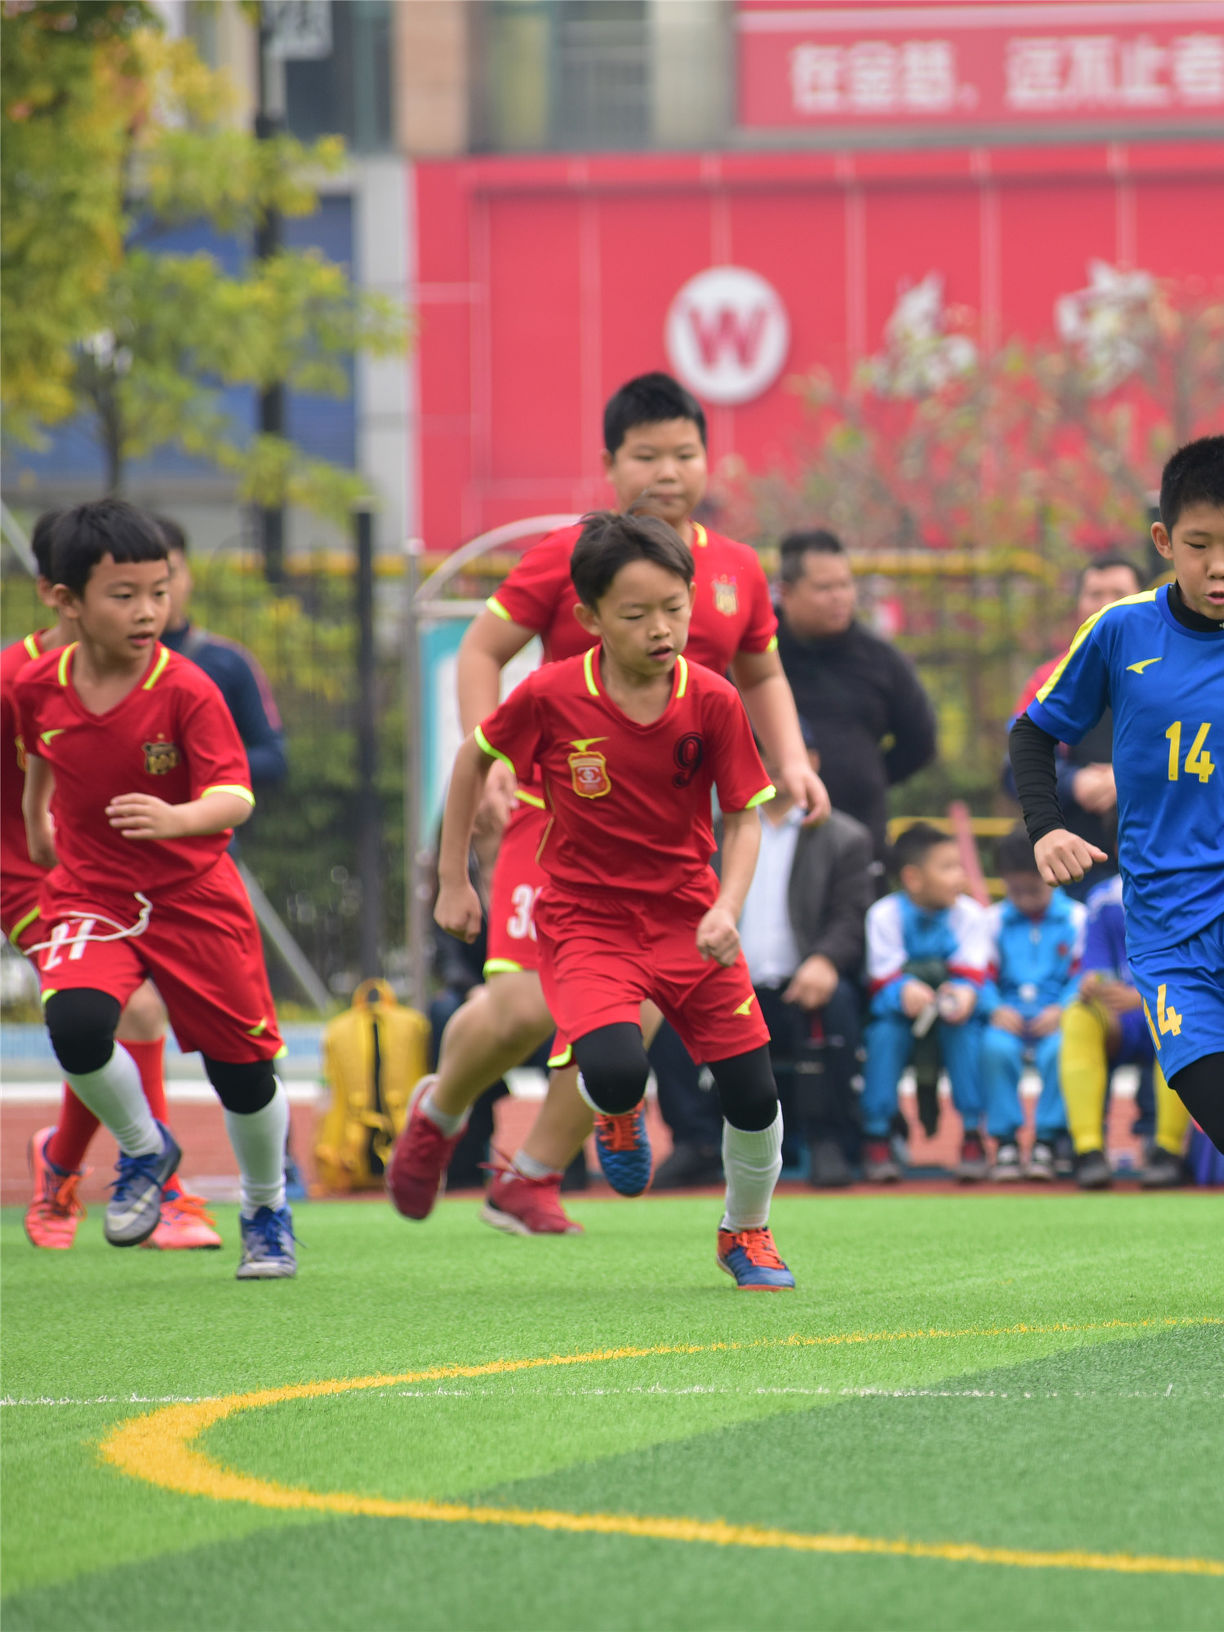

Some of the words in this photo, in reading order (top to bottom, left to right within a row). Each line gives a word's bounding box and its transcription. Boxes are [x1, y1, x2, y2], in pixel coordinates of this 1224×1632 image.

[688, 306, 768, 371] W
[672, 732, 704, 788] 9
[1165, 720, 1216, 784] 14
[507, 883, 543, 941] 3
[1143, 983, 1183, 1051] 14
